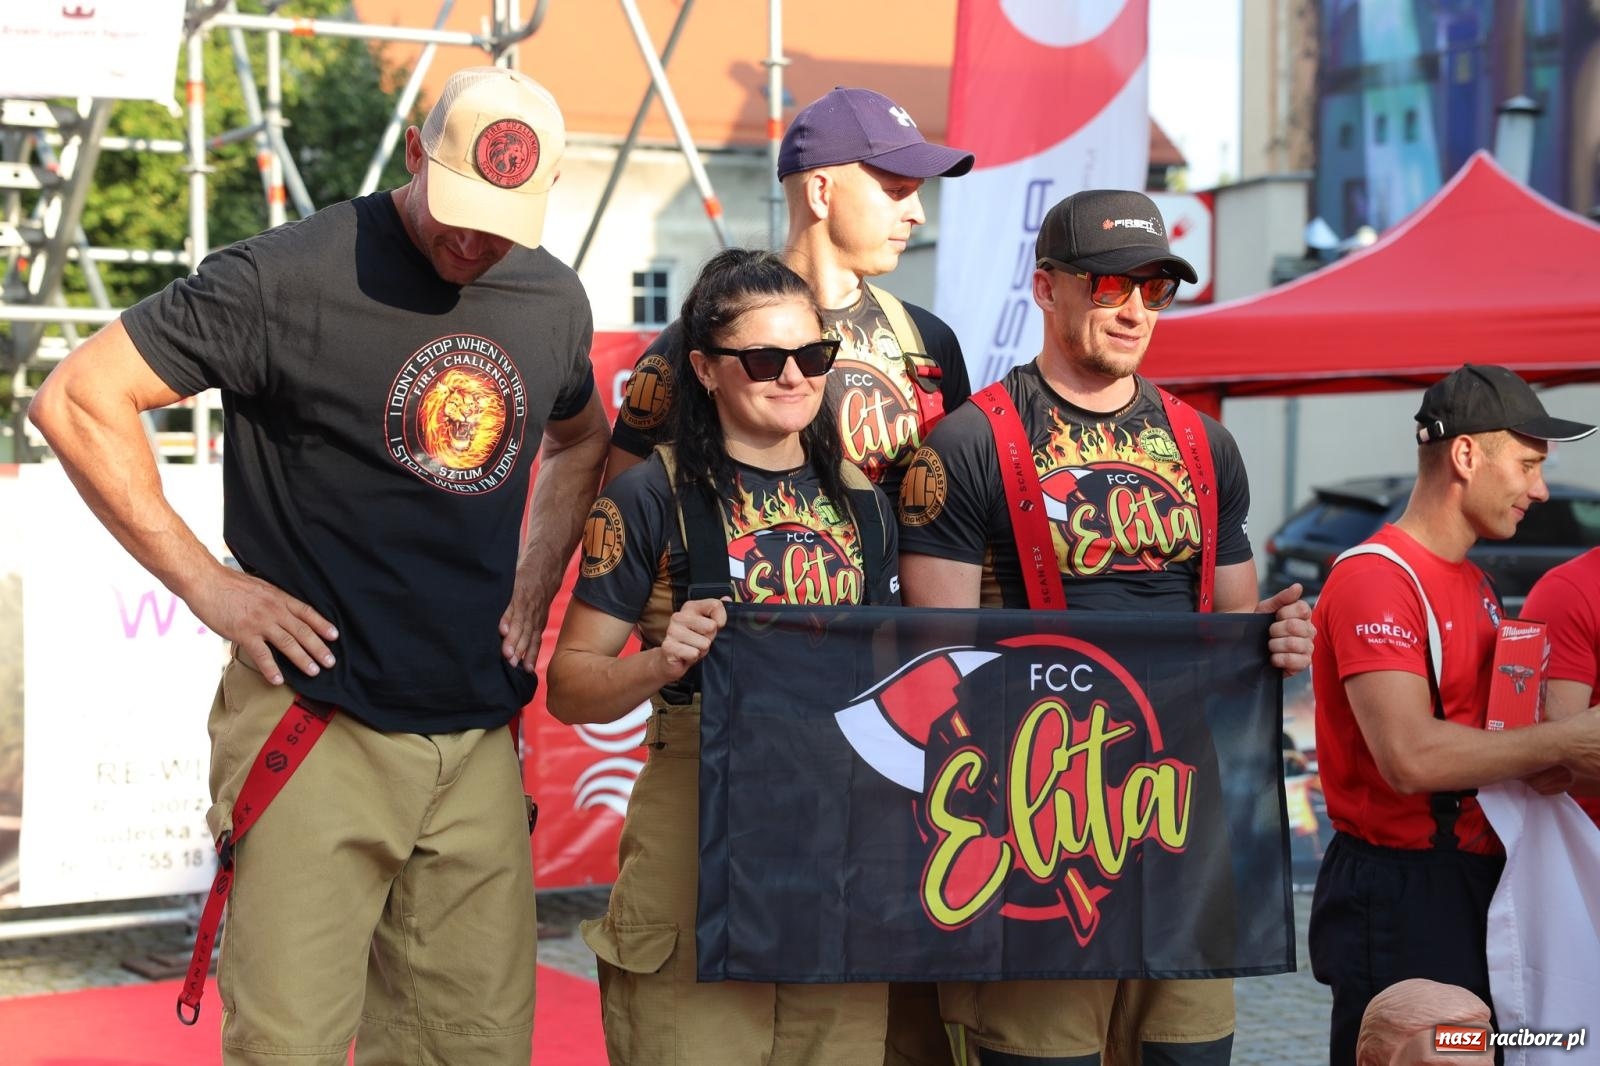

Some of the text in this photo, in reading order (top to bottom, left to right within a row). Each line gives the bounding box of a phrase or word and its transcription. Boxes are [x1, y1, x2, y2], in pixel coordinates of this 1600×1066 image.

[392, 363, 419, 408] DON'T
[417, 339, 452, 368] STOP
[456, 337, 498, 359] WHEN
[498, 352, 512, 374] I'M
[511, 372, 525, 417] TIRED
[413, 354, 511, 397] FIRE CHALLENGE
[844, 373, 873, 387] FCC
[840, 389, 921, 463] lita
[433, 475, 478, 493] WHEN
[479, 475, 498, 490] I'M
[494, 438, 519, 478] DONE
[439, 466, 483, 481] SZTUM
[931, 459, 944, 493] COAST
[1007, 441, 1028, 493] SCANTEX
[1106, 473, 1140, 485] FCC
[611, 512, 622, 545] COAST
[1072, 487, 1200, 575] Elita
[1032, 545, 1052, 604] SCANTEX
[1501, 625, 1541, 638] Milwaukee
[1030, 663, 1093, 691] FCC
[922, 699, 1194, 927] Elita
